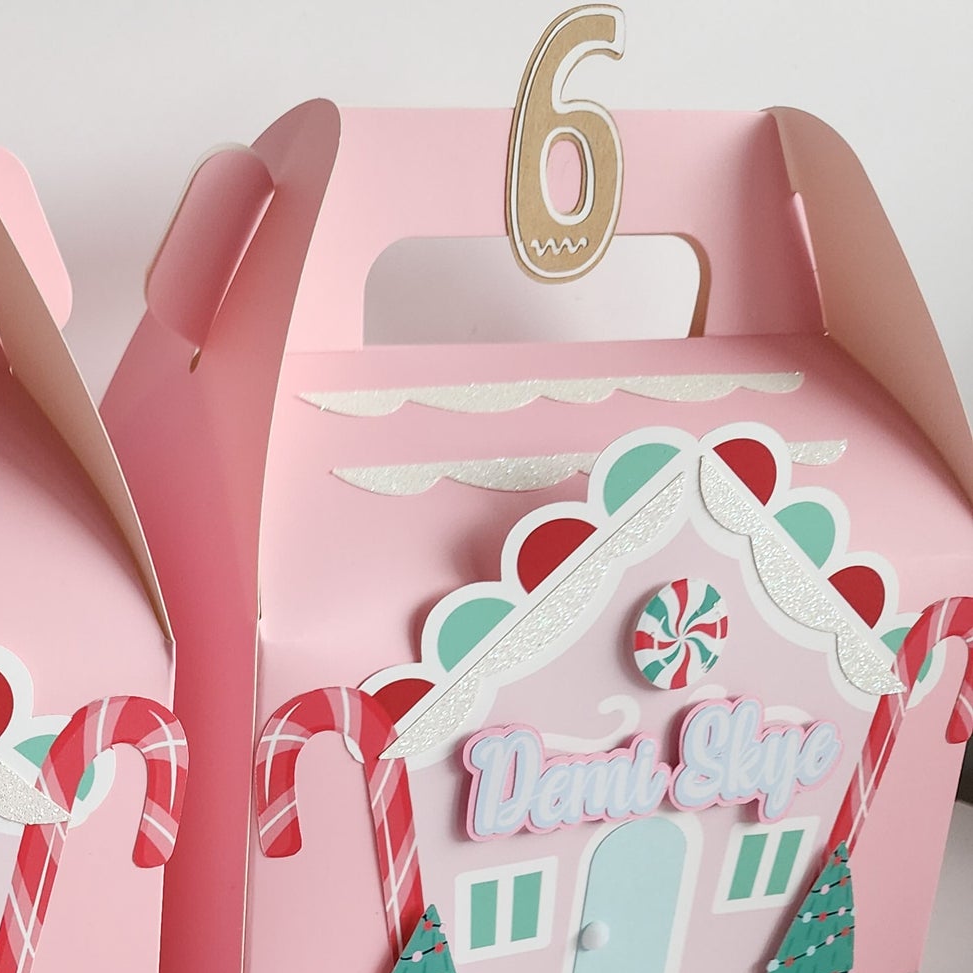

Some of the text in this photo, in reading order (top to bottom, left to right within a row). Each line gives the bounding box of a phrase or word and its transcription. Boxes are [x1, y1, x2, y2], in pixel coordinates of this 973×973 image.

[505, 4, 626, 284] 6
[470, 698, 841, 837] Demi Skye
